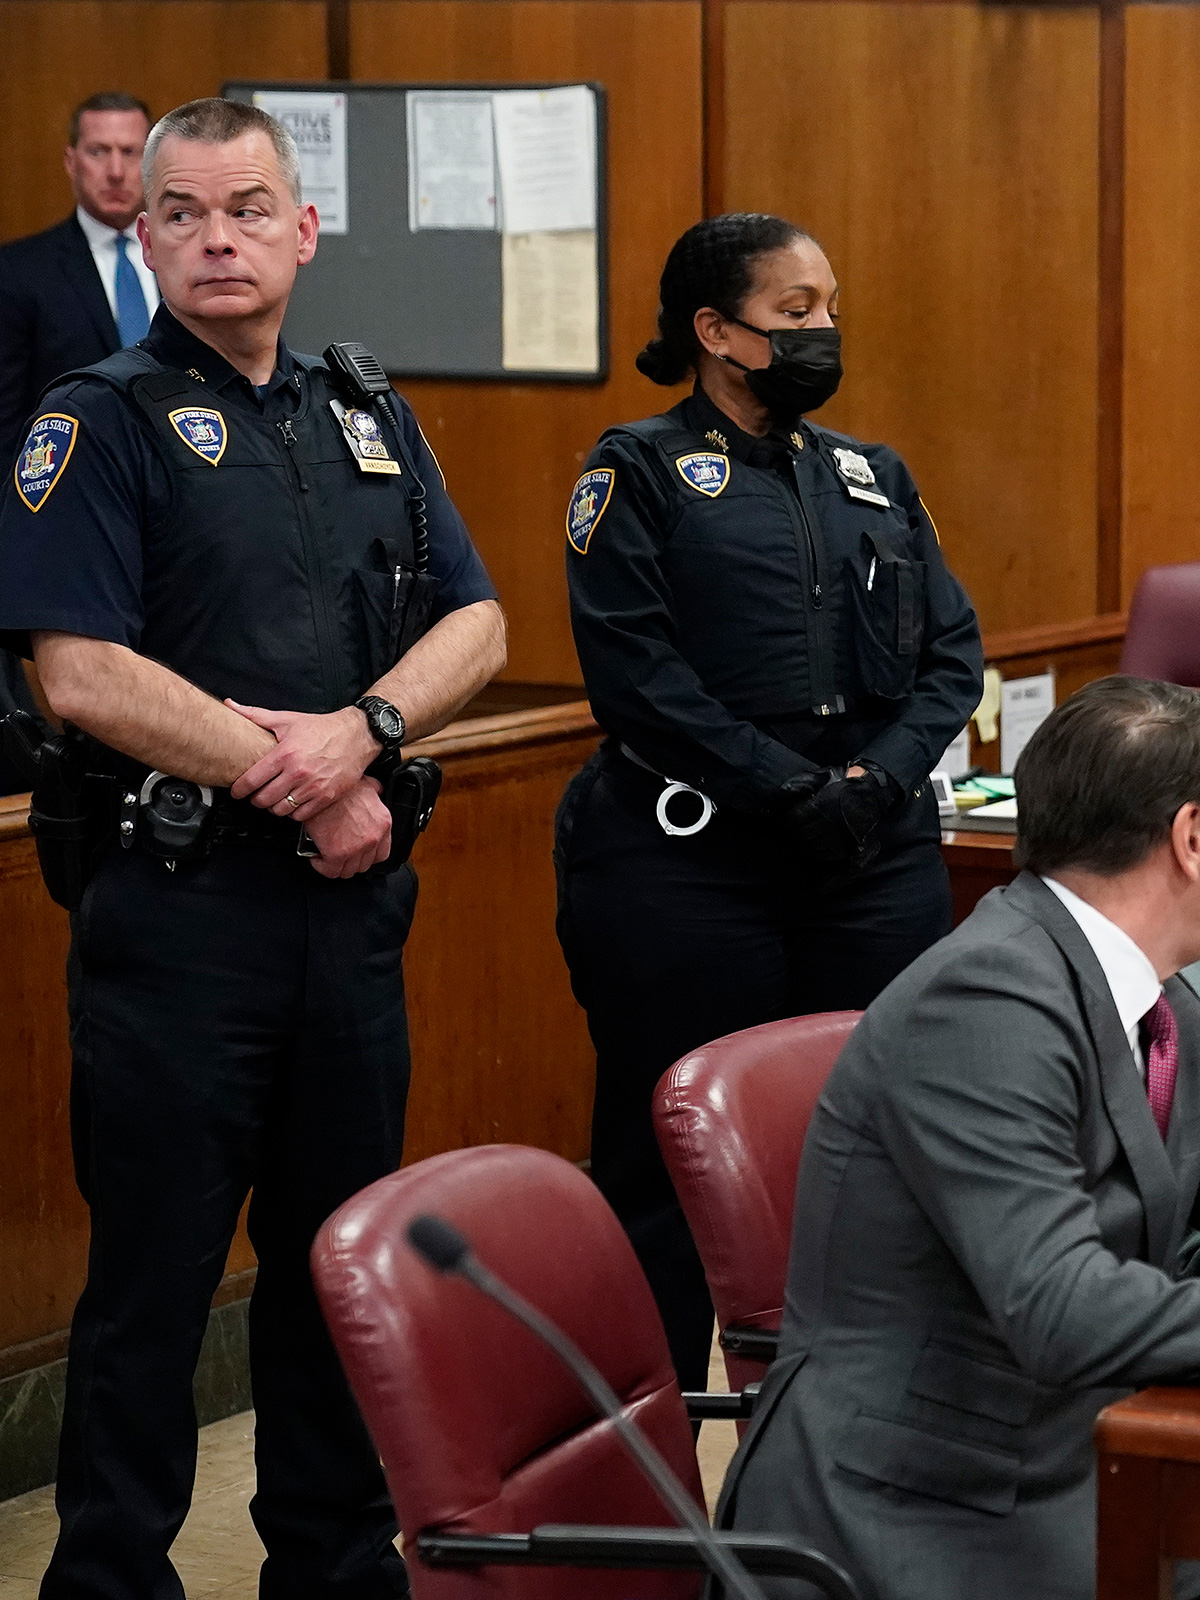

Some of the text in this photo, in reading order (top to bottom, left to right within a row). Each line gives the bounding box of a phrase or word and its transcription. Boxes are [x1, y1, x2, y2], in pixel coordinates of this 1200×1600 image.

[49, 419, 72, 435] STATE
[680, 455, 725, 469] NEW YORK STATE
[591, 472, 611, 484] STATE
[699, 481, 721, 489] COURTS
[23, 478, 51, 493] COURTS
[572, 522, 592, 541] COURTS
